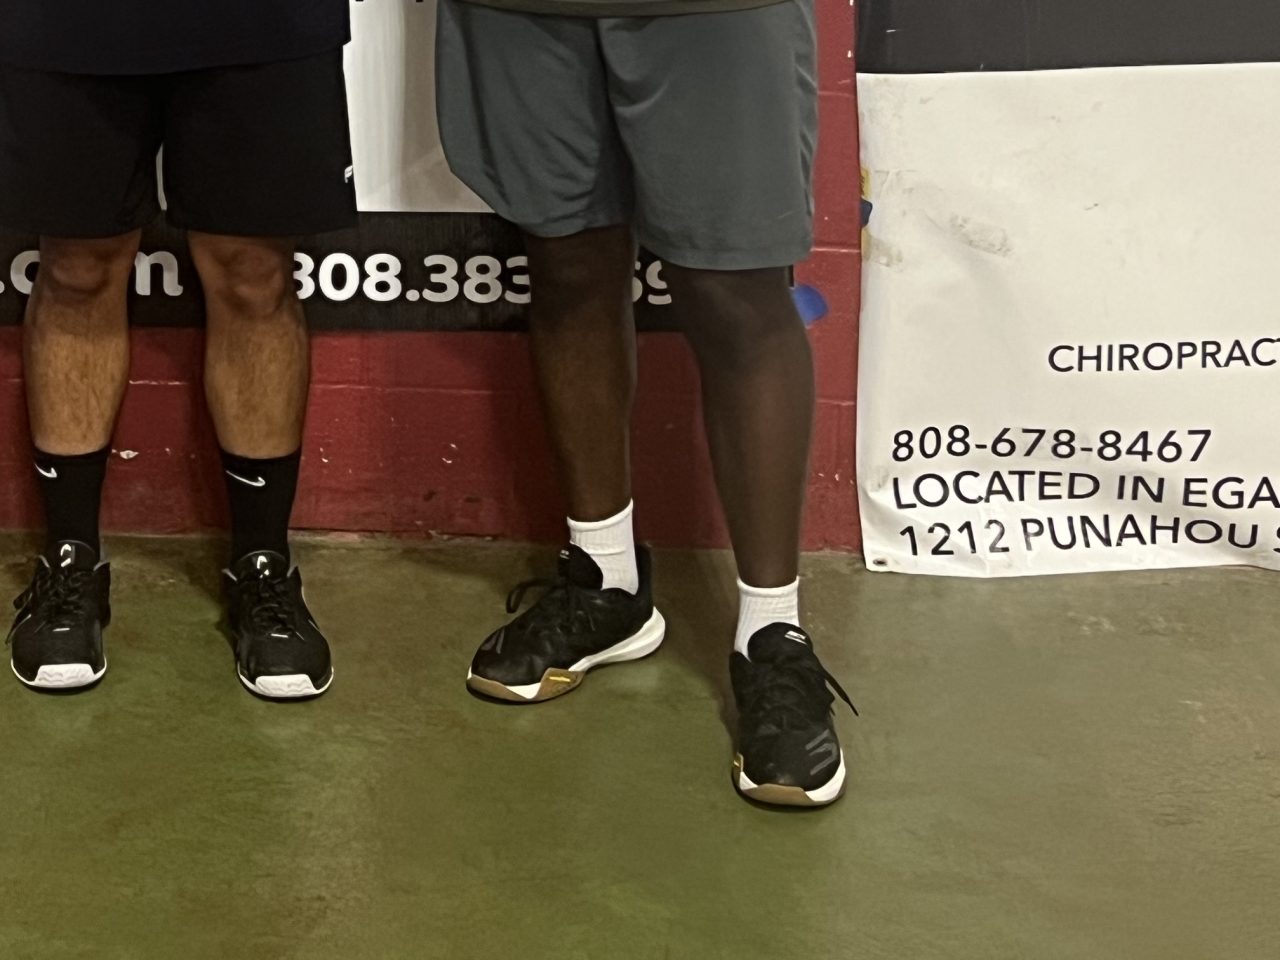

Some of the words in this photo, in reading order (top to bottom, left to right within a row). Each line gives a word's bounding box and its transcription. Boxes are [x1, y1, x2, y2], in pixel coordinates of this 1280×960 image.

[1048, 338, 1280, 372] CHIROPRAC
[892, 425, 1211, 463] 808-678-8467
[893, 471, 1100, 509] LOCATED
[1117, 475, 1164, 503] IN
[1182, 477, 1280, 509] EGA
[900, 520, 1009, 556] 1212
[1021, 514, 1258, 550] PUNAHOU
